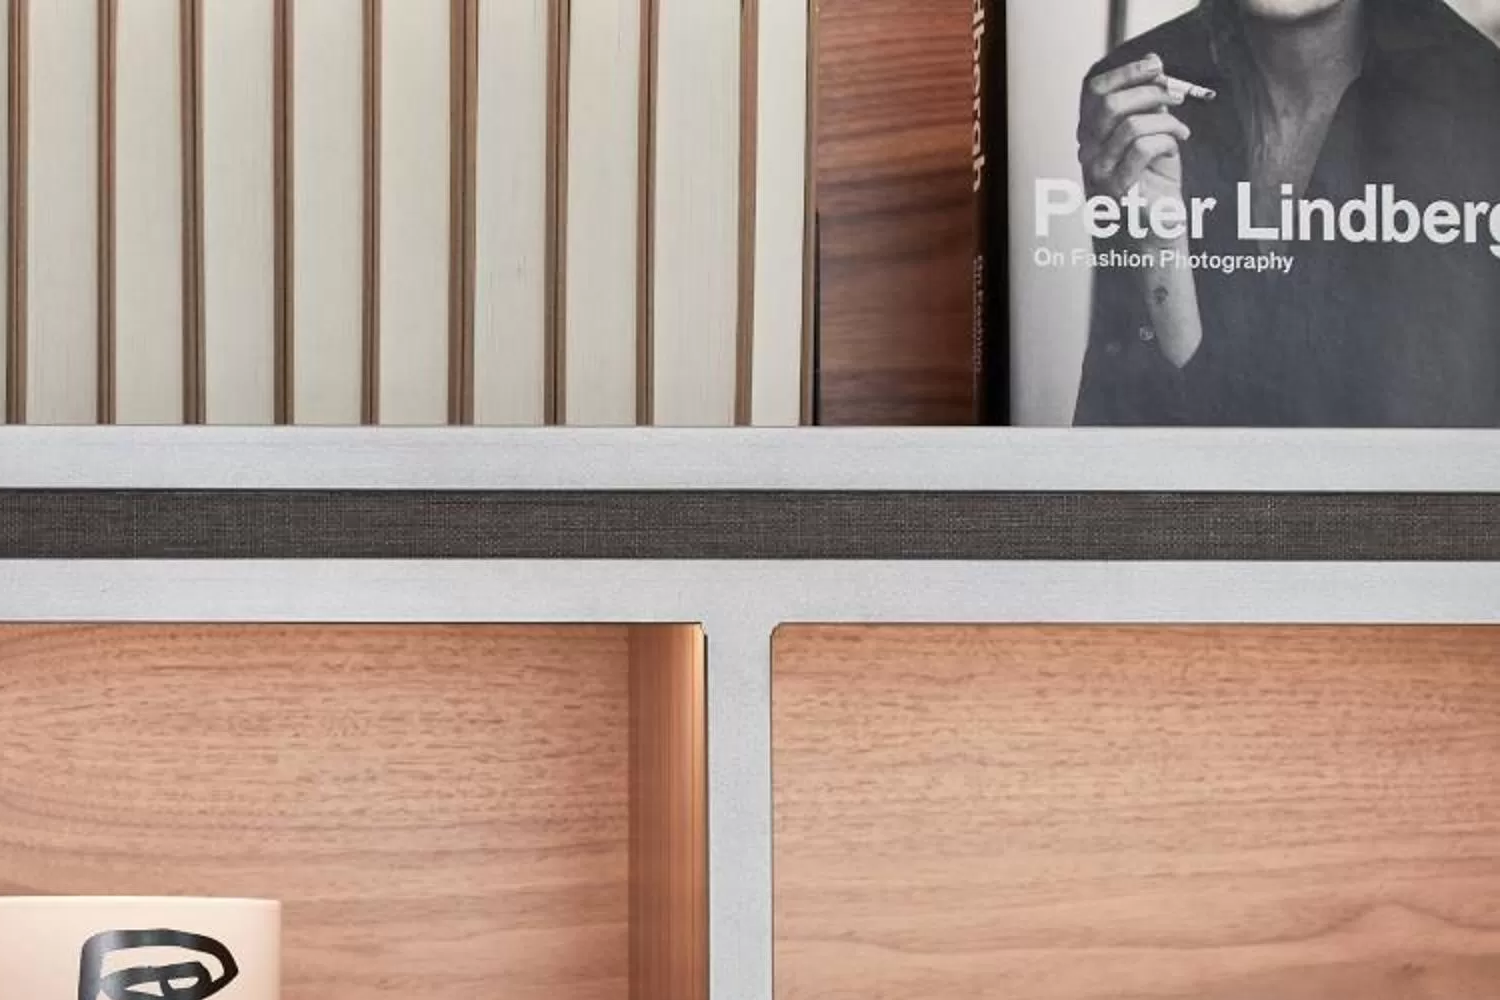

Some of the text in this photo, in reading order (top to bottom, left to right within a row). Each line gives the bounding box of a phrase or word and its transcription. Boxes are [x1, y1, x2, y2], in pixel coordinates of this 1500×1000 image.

[1033, 179, 1217, 239] Peter
[1033, 248, 1294, 273] On Fashion Photography
